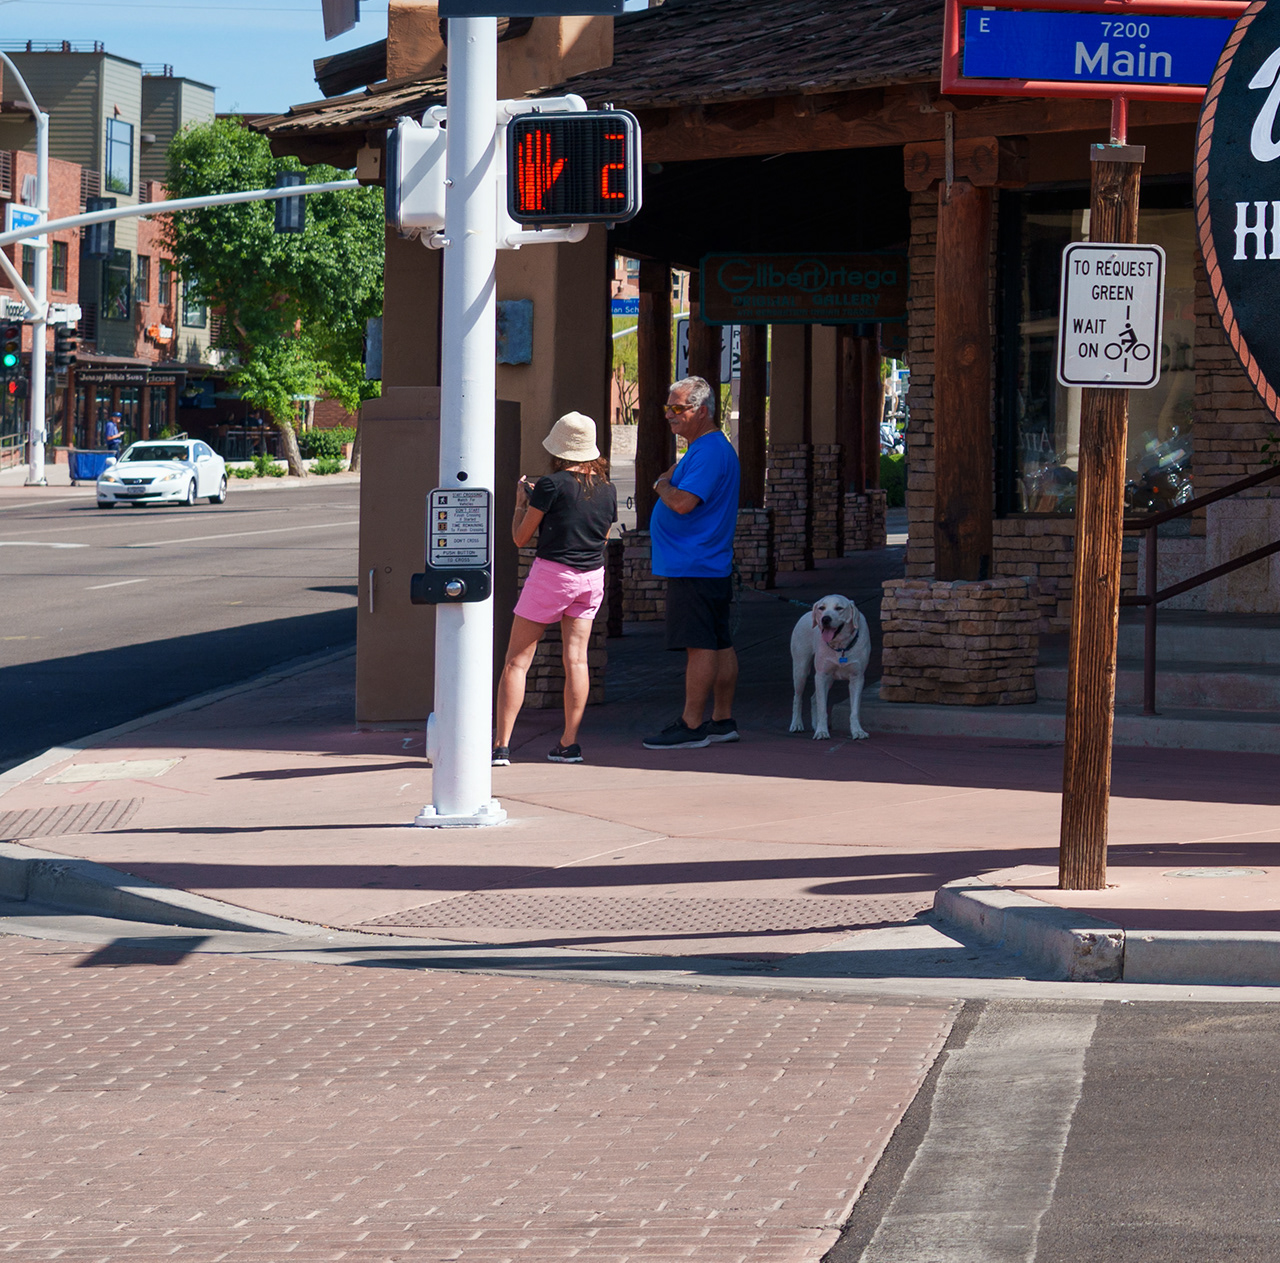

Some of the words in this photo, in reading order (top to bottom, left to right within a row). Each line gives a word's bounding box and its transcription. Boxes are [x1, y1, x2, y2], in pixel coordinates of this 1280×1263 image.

[980, 17, 990, 33] E
[1101, 21, 1150, 39] 7200
[1074, 41, 1172, 78] Main
[601, 133, 625, 200] 2
[717, 259, 822, 293] Gilbert
[1074, 260, 1090, 275] TO
[1096, 261, 1154, 277] REQUEST
[733, 295, 796, 307] ORIGINAL
[812, 294, 881, 306] GALLERY
[1092, 285, 1134, 300] GREEN
[1073, 318, 1107, 334] WAIT
[1078, 343, 1099, 358] ON
